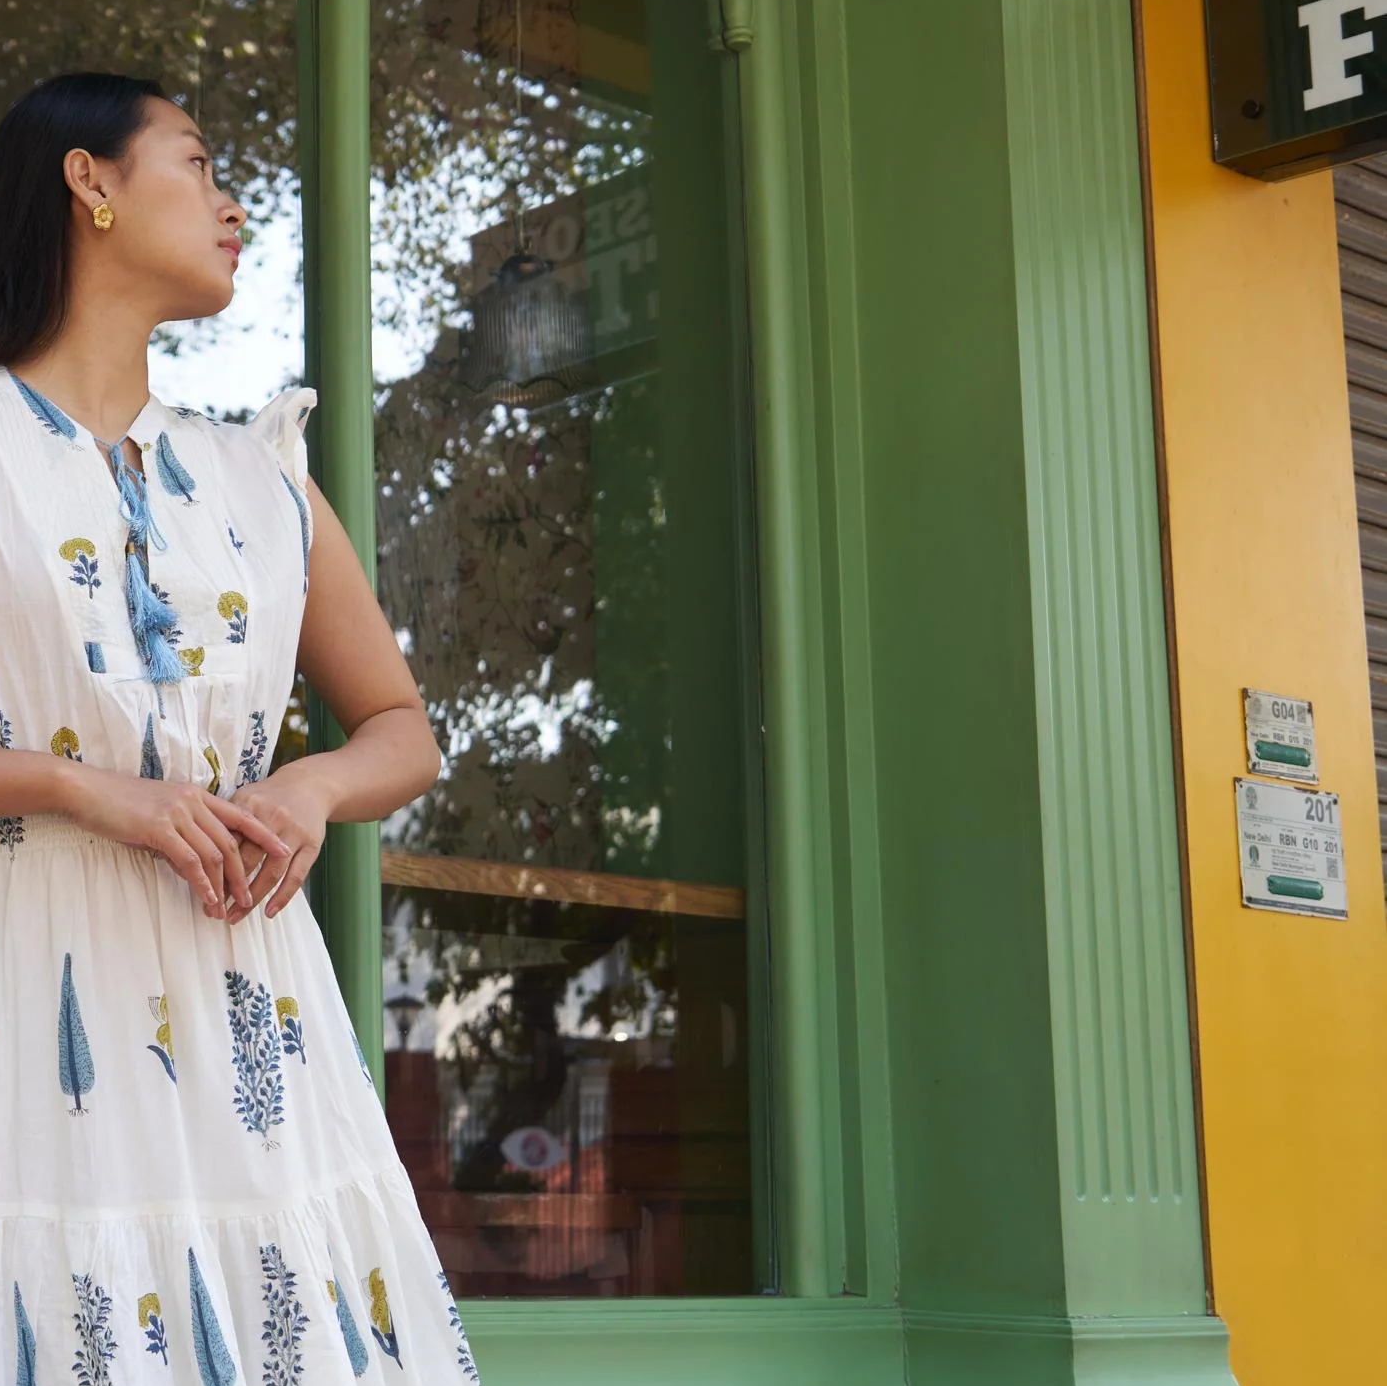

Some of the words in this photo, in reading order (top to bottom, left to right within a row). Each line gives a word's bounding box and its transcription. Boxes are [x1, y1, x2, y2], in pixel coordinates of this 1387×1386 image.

[1271, 700, 1295, 722] G04
[1304, 796, 1334, 824] 201
[1278, 832, 1298, 847] RBN
[1302, 836, 1319, 851] G10
[1323, 840, 1339, 854] 201
